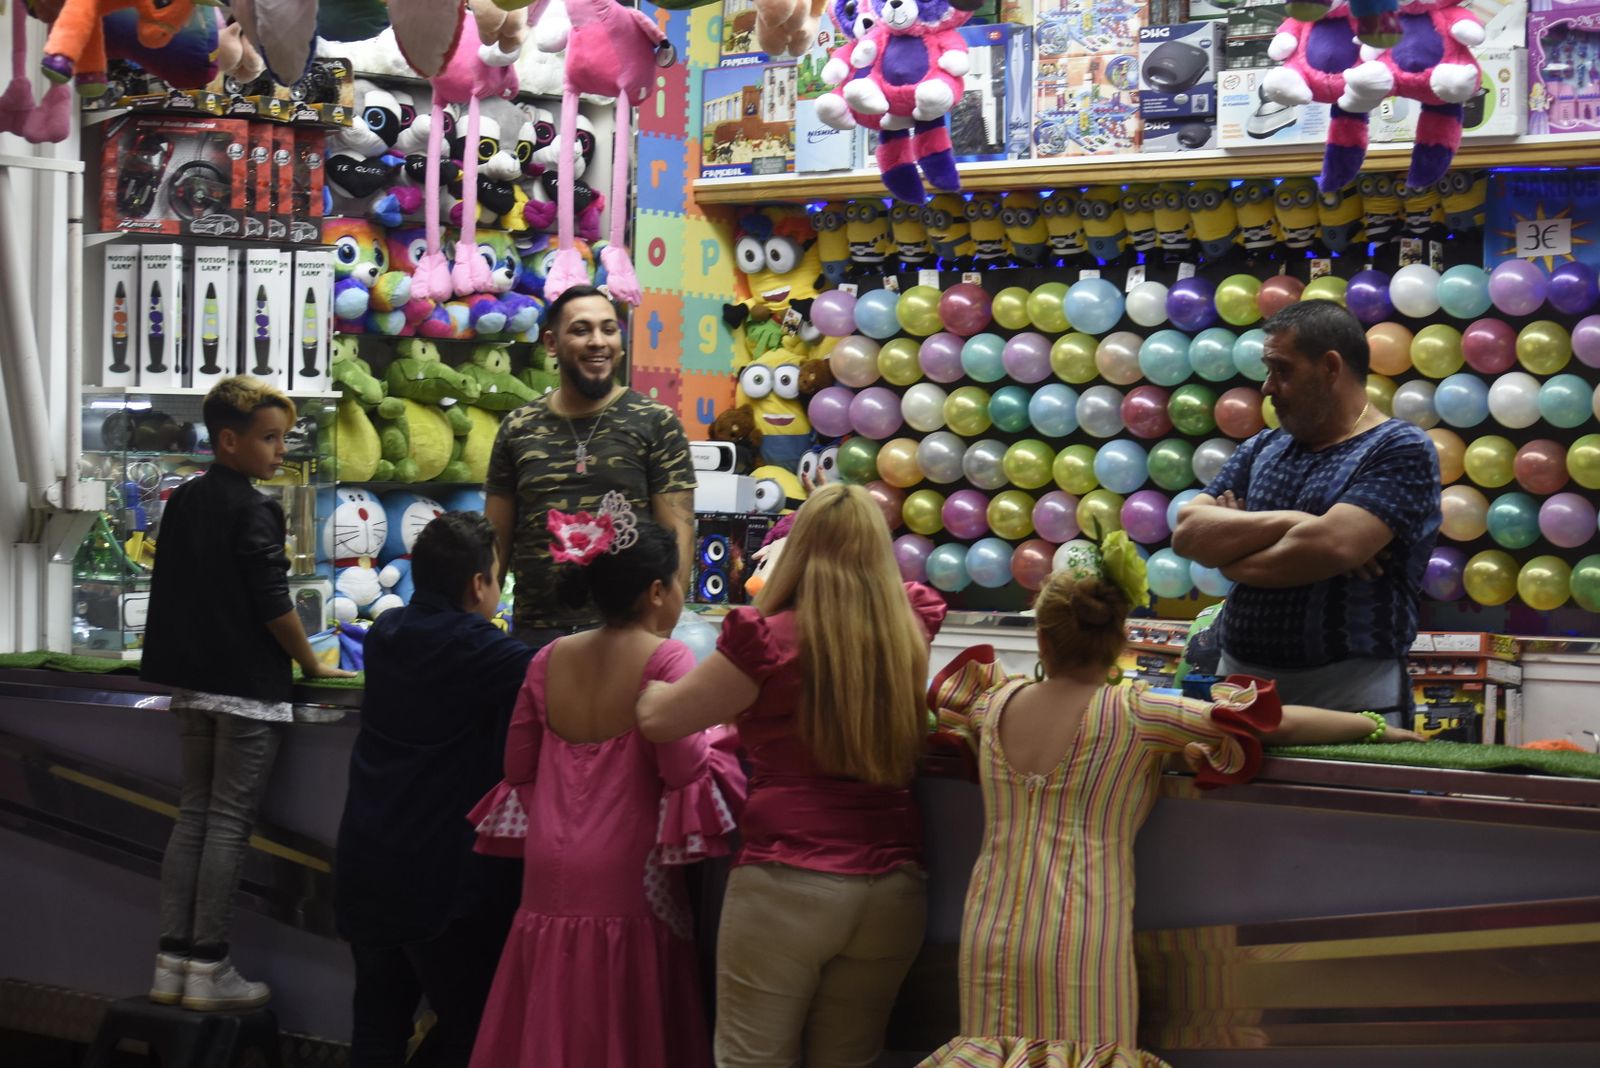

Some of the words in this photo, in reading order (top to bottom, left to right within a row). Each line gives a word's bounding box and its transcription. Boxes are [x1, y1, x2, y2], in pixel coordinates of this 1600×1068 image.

[1523, 223, 1560, 251] 3€
[700, 239, 720, 276] p
[698, 314, 718, 354] g
